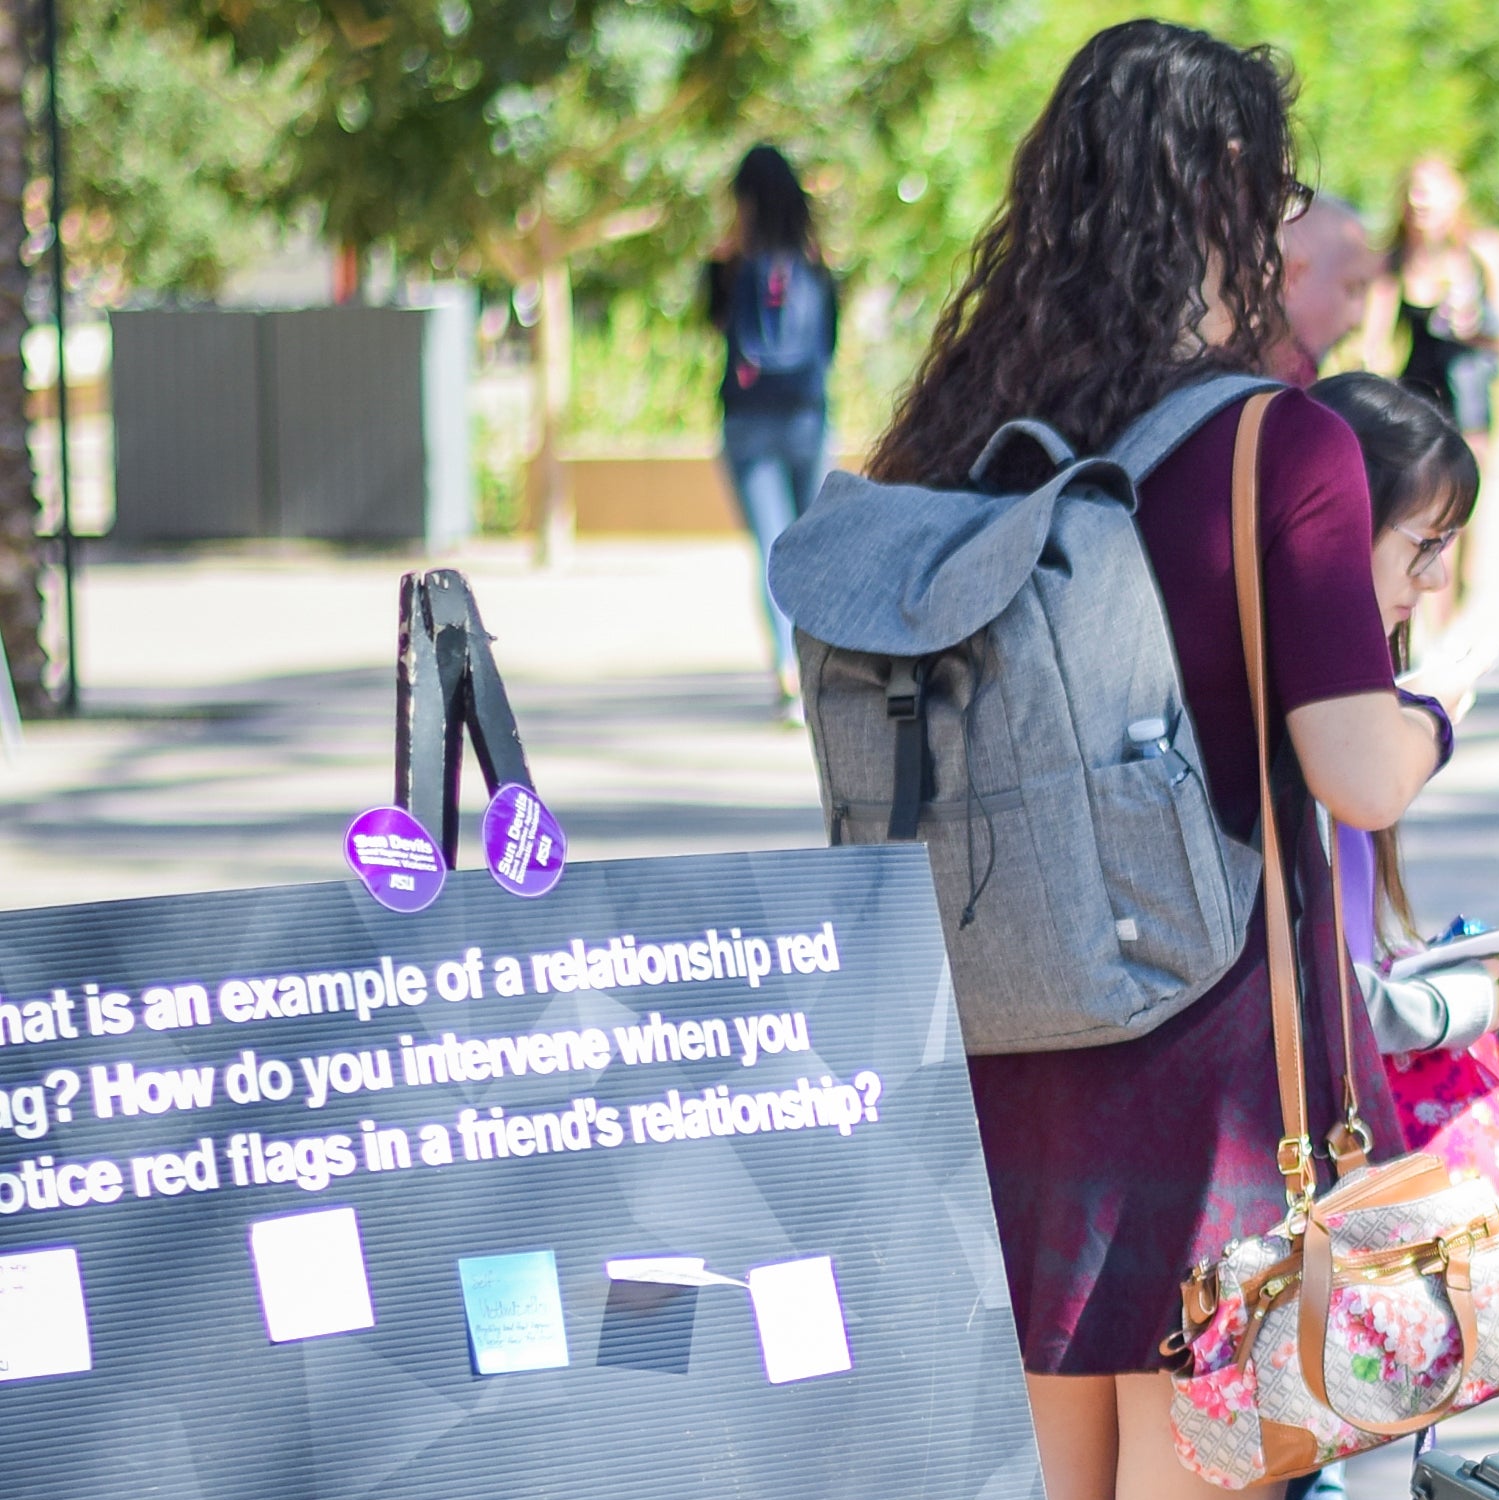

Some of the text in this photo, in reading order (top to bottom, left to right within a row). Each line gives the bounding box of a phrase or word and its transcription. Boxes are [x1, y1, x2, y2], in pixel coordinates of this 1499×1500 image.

[84, 983, 135, 1036] is
[144, 984, 211, 1030] an
[219, 956, 428, 1023] example
[436, 947, 485, 1002] of
[495, 954, 525, 998] a
[532, 928, 772, 993] relationship
[777, 921, 840, 975] red
[91, 1063, 214, 1118] How
[226, 1050, 294, 1104] do
[301, 1049, 393, 1109] you
[400, 1026, 611, 1086] intervene
[615, 1012, 730, 1065] when
[730, 1012, 810, 1066] you
[131, 1137, 219, 1198] red
[227, 1132, 356, 1191] flags
[360, 1120, 412, 1172] in
[419, 1123, 453, 1165] a
[457, 1097, 624, 1161] friend's
[629, 1070, 882, 1144] relationship?
